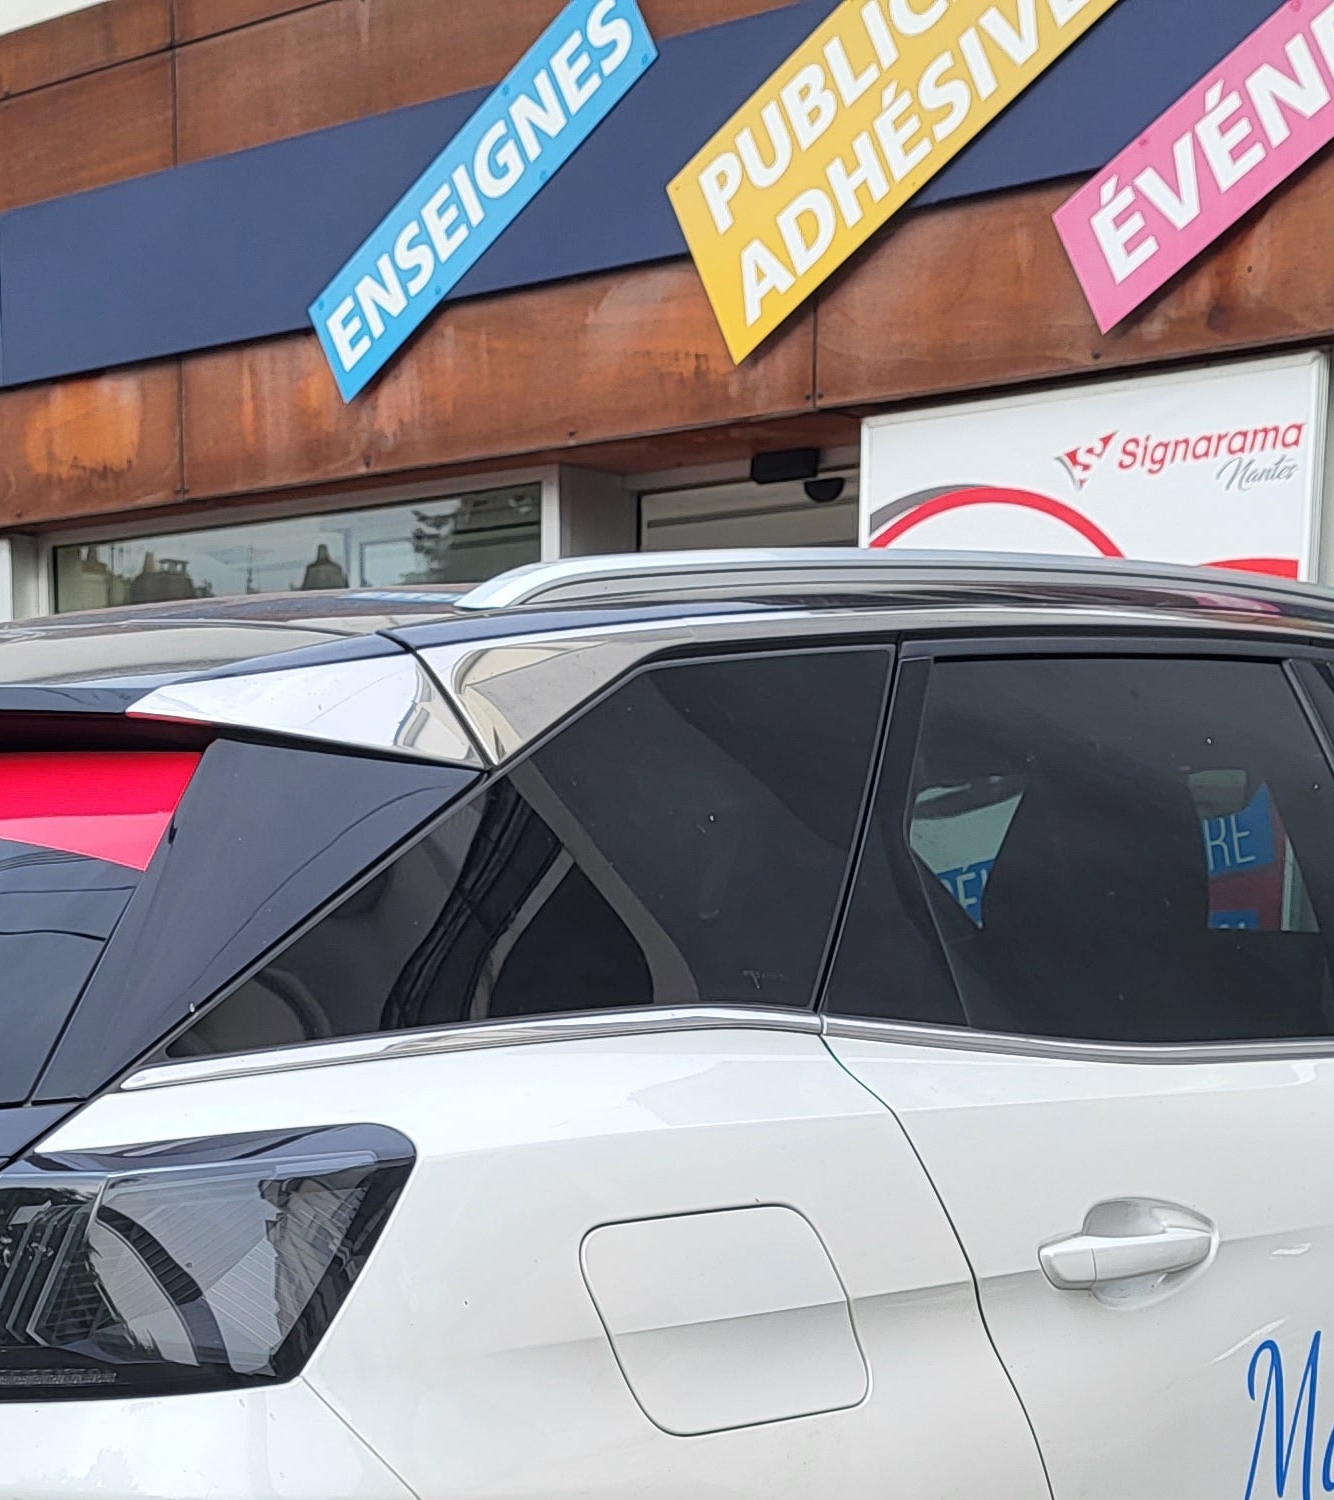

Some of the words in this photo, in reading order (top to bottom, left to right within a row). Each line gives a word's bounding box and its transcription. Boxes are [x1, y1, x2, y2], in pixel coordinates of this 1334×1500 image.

[325, 0, 635, 373] ENSEIGNES
[698, 0, 959, 235] PUBLIC
[1117, 422, 1306, 475] Signarama
[1216, 454, 1299, 491] Nantes
